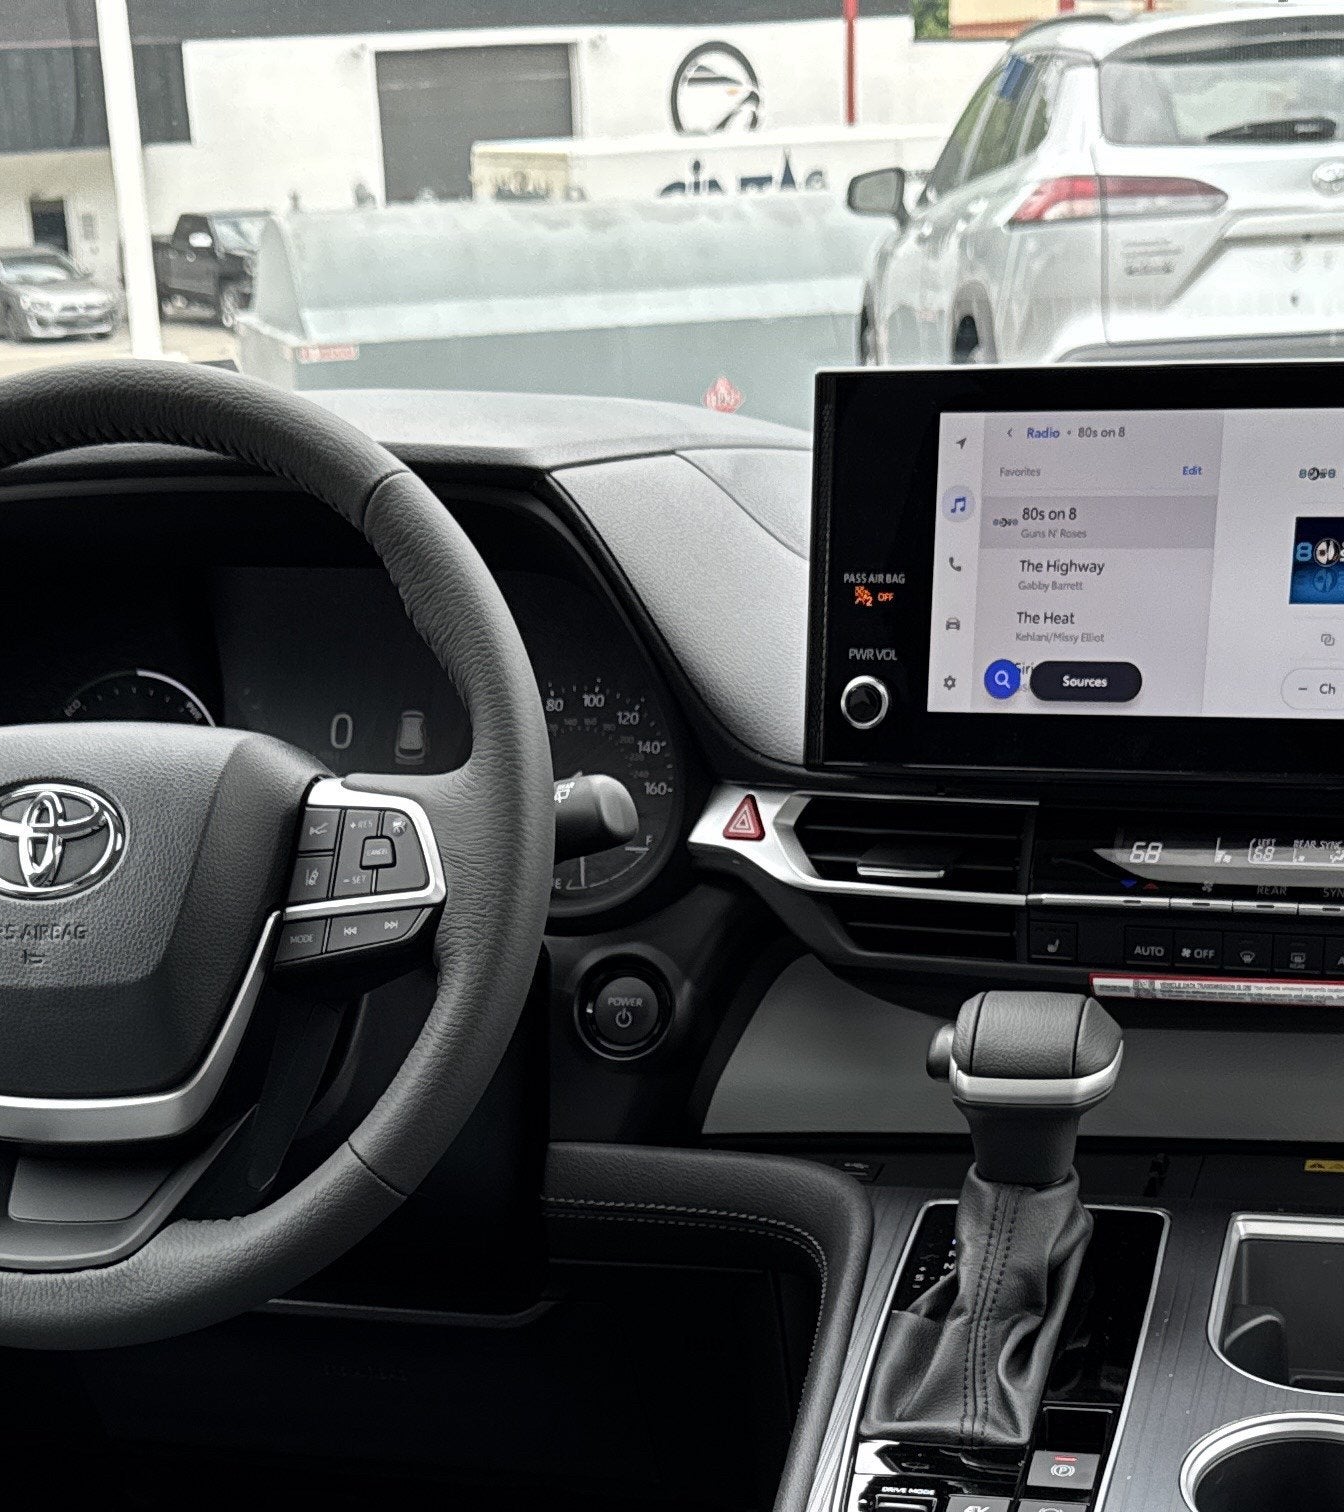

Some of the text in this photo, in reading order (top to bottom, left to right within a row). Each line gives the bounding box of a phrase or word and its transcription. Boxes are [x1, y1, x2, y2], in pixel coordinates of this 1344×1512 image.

[1026, 427, 1126, 439] Radio 80s on 8
[999, 467, 1041, 477] Favorites
[1182, 465, 1202, 476] Edit
[1022, 507, 1077, 521] 80s on 8
[1021, 528, 1045, 539] Guns
[1060, 528, 1087, 539] Roses
[1019, 559, 1105, 576] The Highway
[843, 573, 906, 584] PASS AIR BAG
[1018, 581, 1083, 592] Gabby Barrett
[877, 592, 894, 602] OFF
[1016, 612, 1075, 625] The Heat
[848, 648, 898, 661] PWR VOL
[1062, 675, 1107, 688] Sources
[1319, 684, 1336, 695] Ch
[546, 699, 564, 712] 80
[582, 694, 605, 707] 100
[616, 711, 640, 726] 120
[330, 713, 353, 749] 0
[637, 741, 661, 754] 140
[644, 782, 667, 796] 160
[646, 835, 654, 845] F
[1129, 841, 1163, 863] 68
[1257, 885, 1287, 896] REAR
[20, 922, 88, 941] AIRBAG
[1134, 946, 1164, 957] AUTO
[1193, 949, 1215, 959] OFF
[608, 997, 643, 1007] POWER
[882, 1486, 935, 1496] DRIVE MODE
